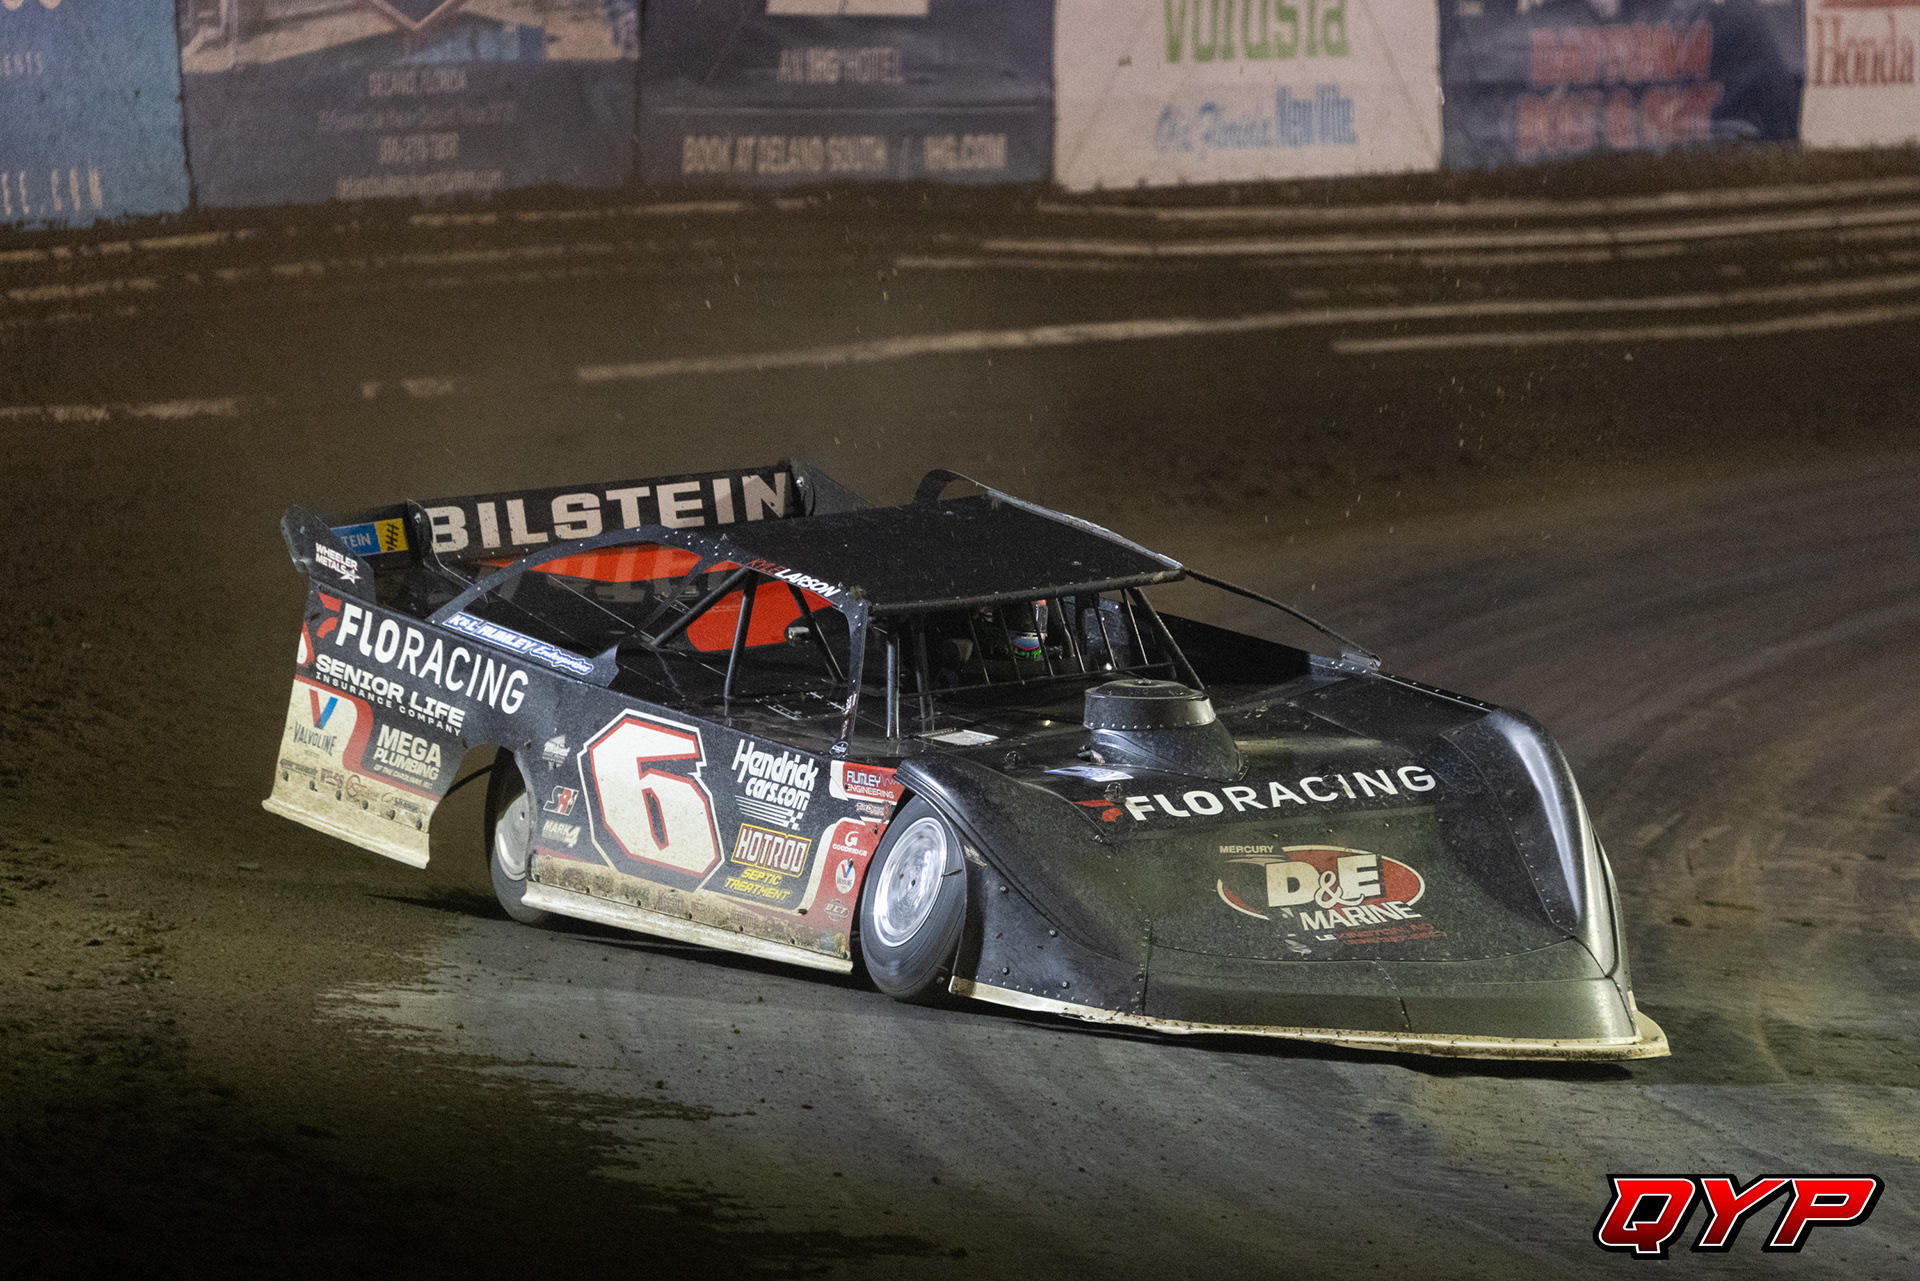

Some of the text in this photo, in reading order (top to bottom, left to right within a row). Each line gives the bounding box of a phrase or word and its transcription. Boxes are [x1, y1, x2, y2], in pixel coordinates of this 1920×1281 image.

[1813, 10, 1915, 87] Honda
[682, 136, 731, 174] BOOK
[733, 136, 755, 173] AT
[425, 472, 788, 554] BILSTEIN
[315, 542, 358, 571] WHEELER
[341, 533, 371, 548] TEIN
[315, 553, 348, 575] METALS
[745, 557, 841, 598] KYLE LARSON
[477, 623, 535, 653] RUMLEY
[335, 602, 529, 715] FLORACING
[315, 653, 466, 728] SENIOR LIFE
[315, 671, 461, 736] INSURANCE COMPANY
[293, 721, 337, 757] VALVOLINE
[377, 724, 441, 768] MEGA
[373, 747, 440, 781] PLUMBING
[731, 738, 819, 792] Hendrick
[588, 716, 721, 878] 6
[745, 777, 811, 812] cars.com
[1125, 765, 1437, 822] FLORACING
[832, 843, 868, 857] GOODRIDGE
[1219, 845, 1275, 854] MERCURY
[724, 877, 791, 901] TREATMENT
[741, 868, 783, 886] SEPTIC
[1265, 853, 1383, 909] D&E
[1300, 900, 1422, 932] MARINE
